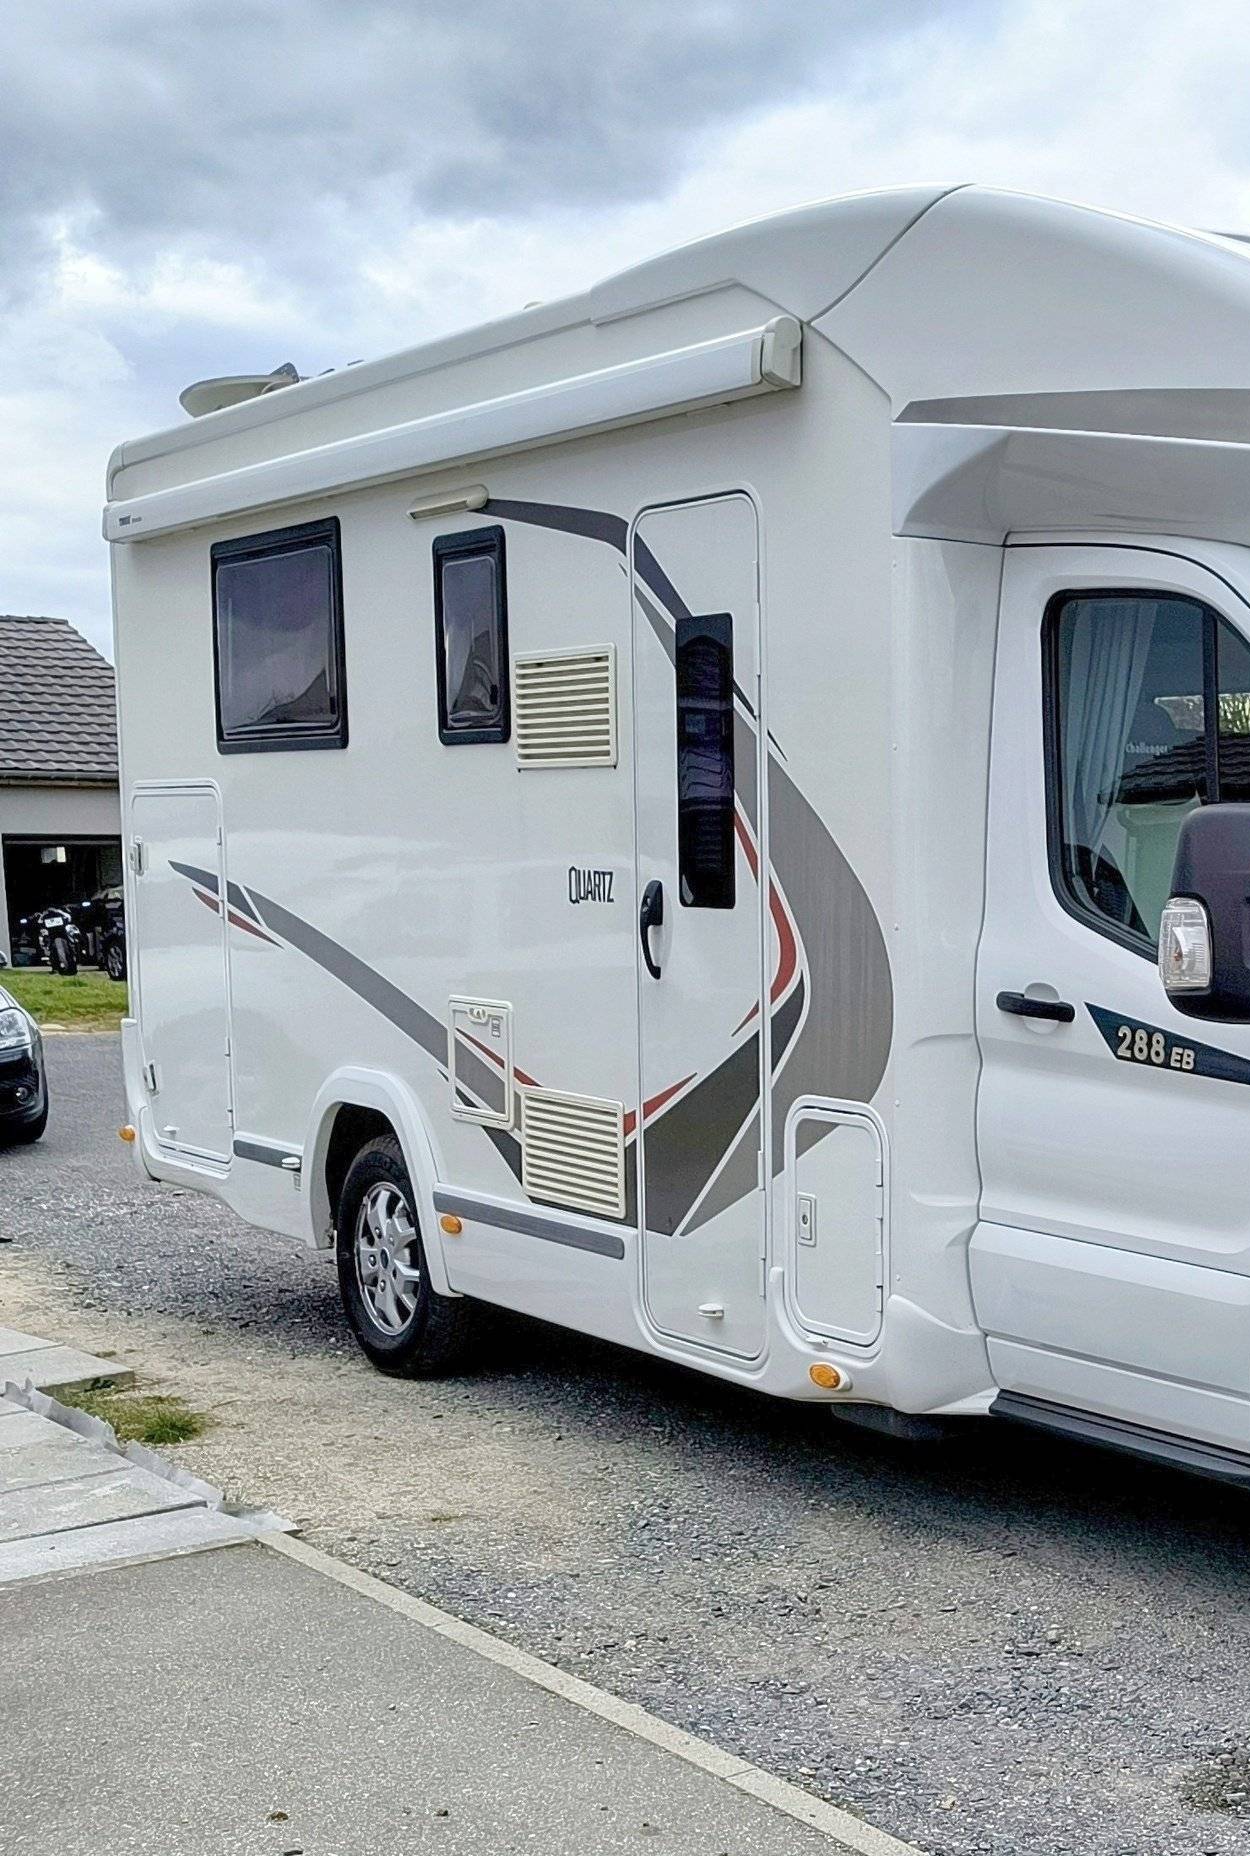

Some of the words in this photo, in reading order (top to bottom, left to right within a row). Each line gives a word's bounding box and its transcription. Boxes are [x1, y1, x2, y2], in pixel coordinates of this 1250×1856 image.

[568, 866, 614, 904] QUARTZ
[1117, 1026, 1166, 1064] 288
[1170, 1047, 1195, 1070] EB
